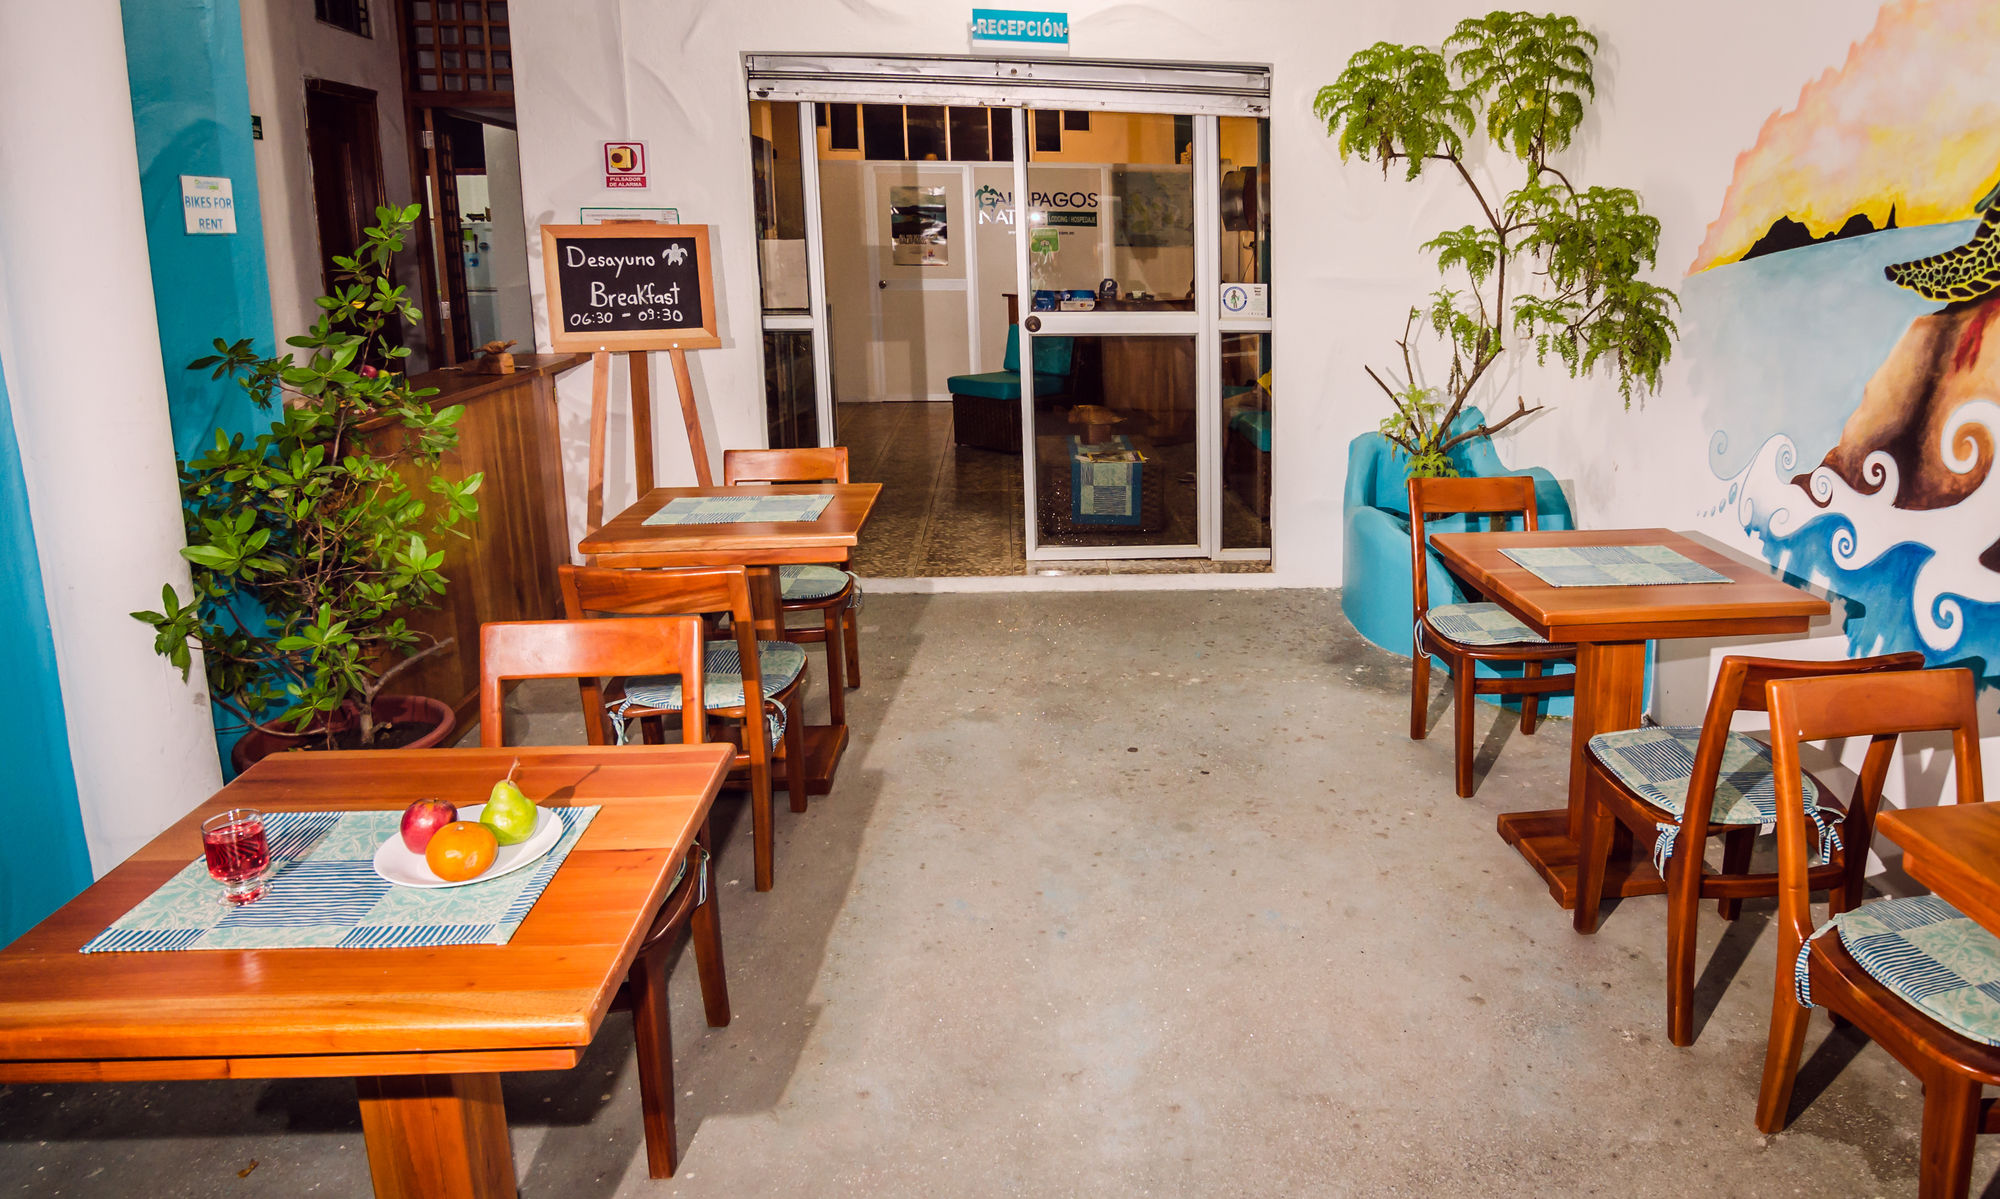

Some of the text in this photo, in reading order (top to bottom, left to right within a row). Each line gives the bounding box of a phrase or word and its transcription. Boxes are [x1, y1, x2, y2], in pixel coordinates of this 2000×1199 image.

[977, 17, 1064, 38] RECEPCIÓN
[184, 195, 232, 209] BIKES FOR
[978, 189, 1098, 208] GALPAGOS
[198, 217, 224, 230] RENT
[566, 245, 656, 279] Desayuno
[590, 281, 681, 308] Breakfast
[570, 312, 613, 326] 06:30
[638, 308, 684, 323] 09:30
